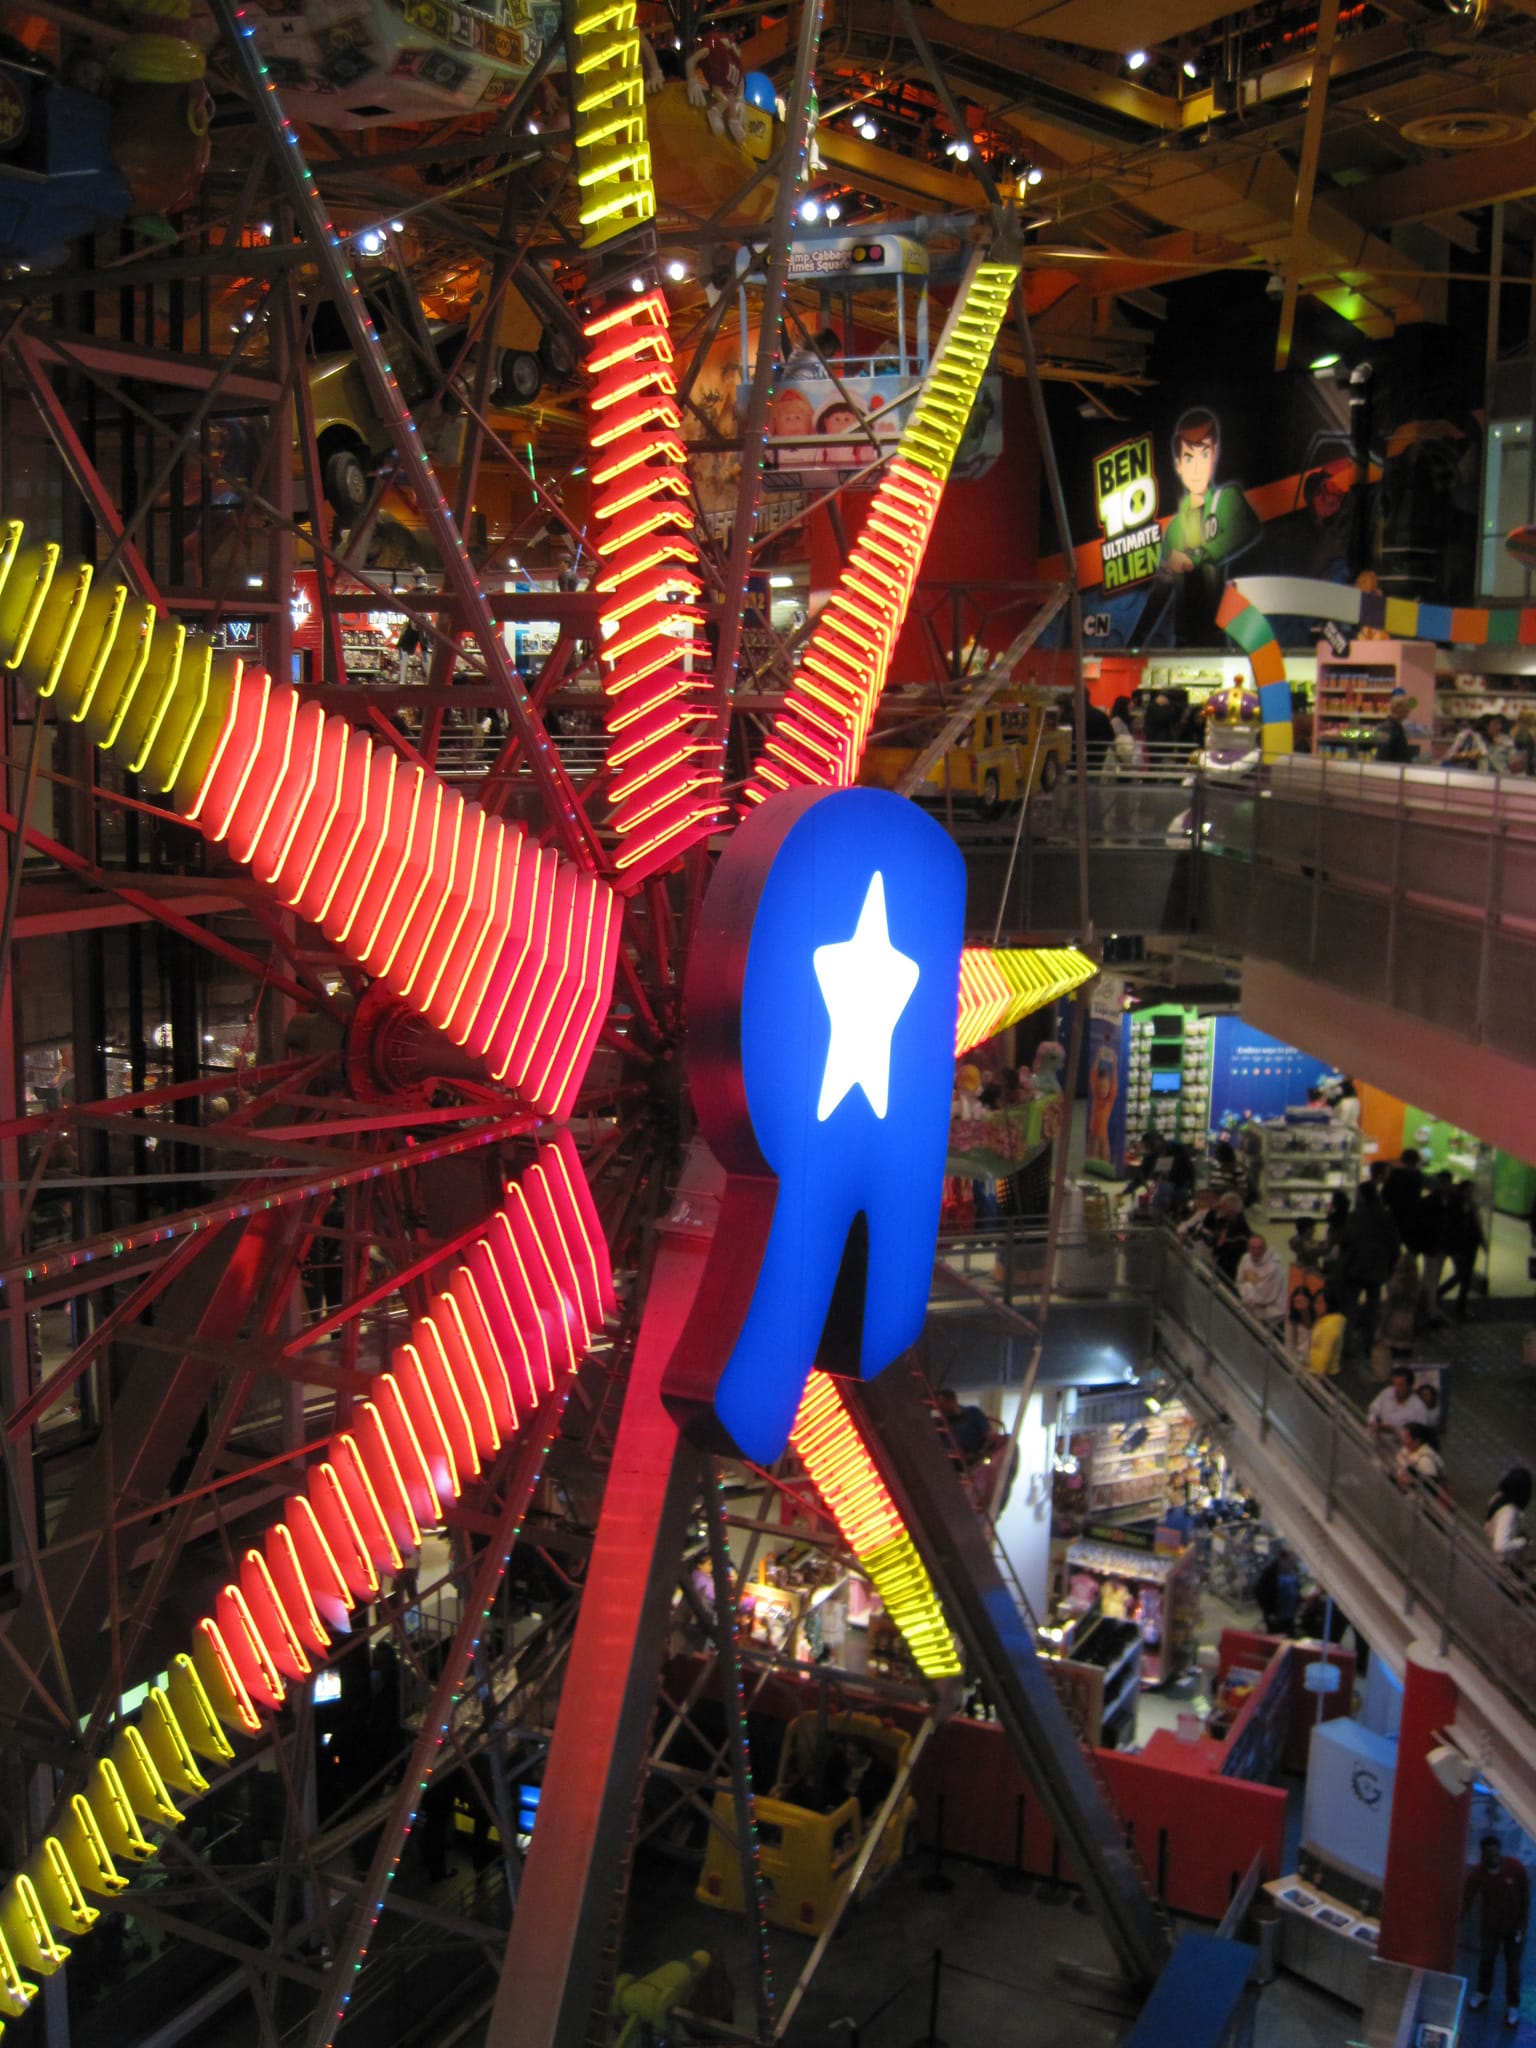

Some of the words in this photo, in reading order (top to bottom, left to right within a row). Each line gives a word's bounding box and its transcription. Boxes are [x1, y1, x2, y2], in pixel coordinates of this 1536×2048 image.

[1099, 443, 1148, 497] BEN
[1100, 477, 1157, 538] 10
[1103, 524, 1161, 561] ULTIMATE
[1105, 545, 1162, 591] ALIEN
